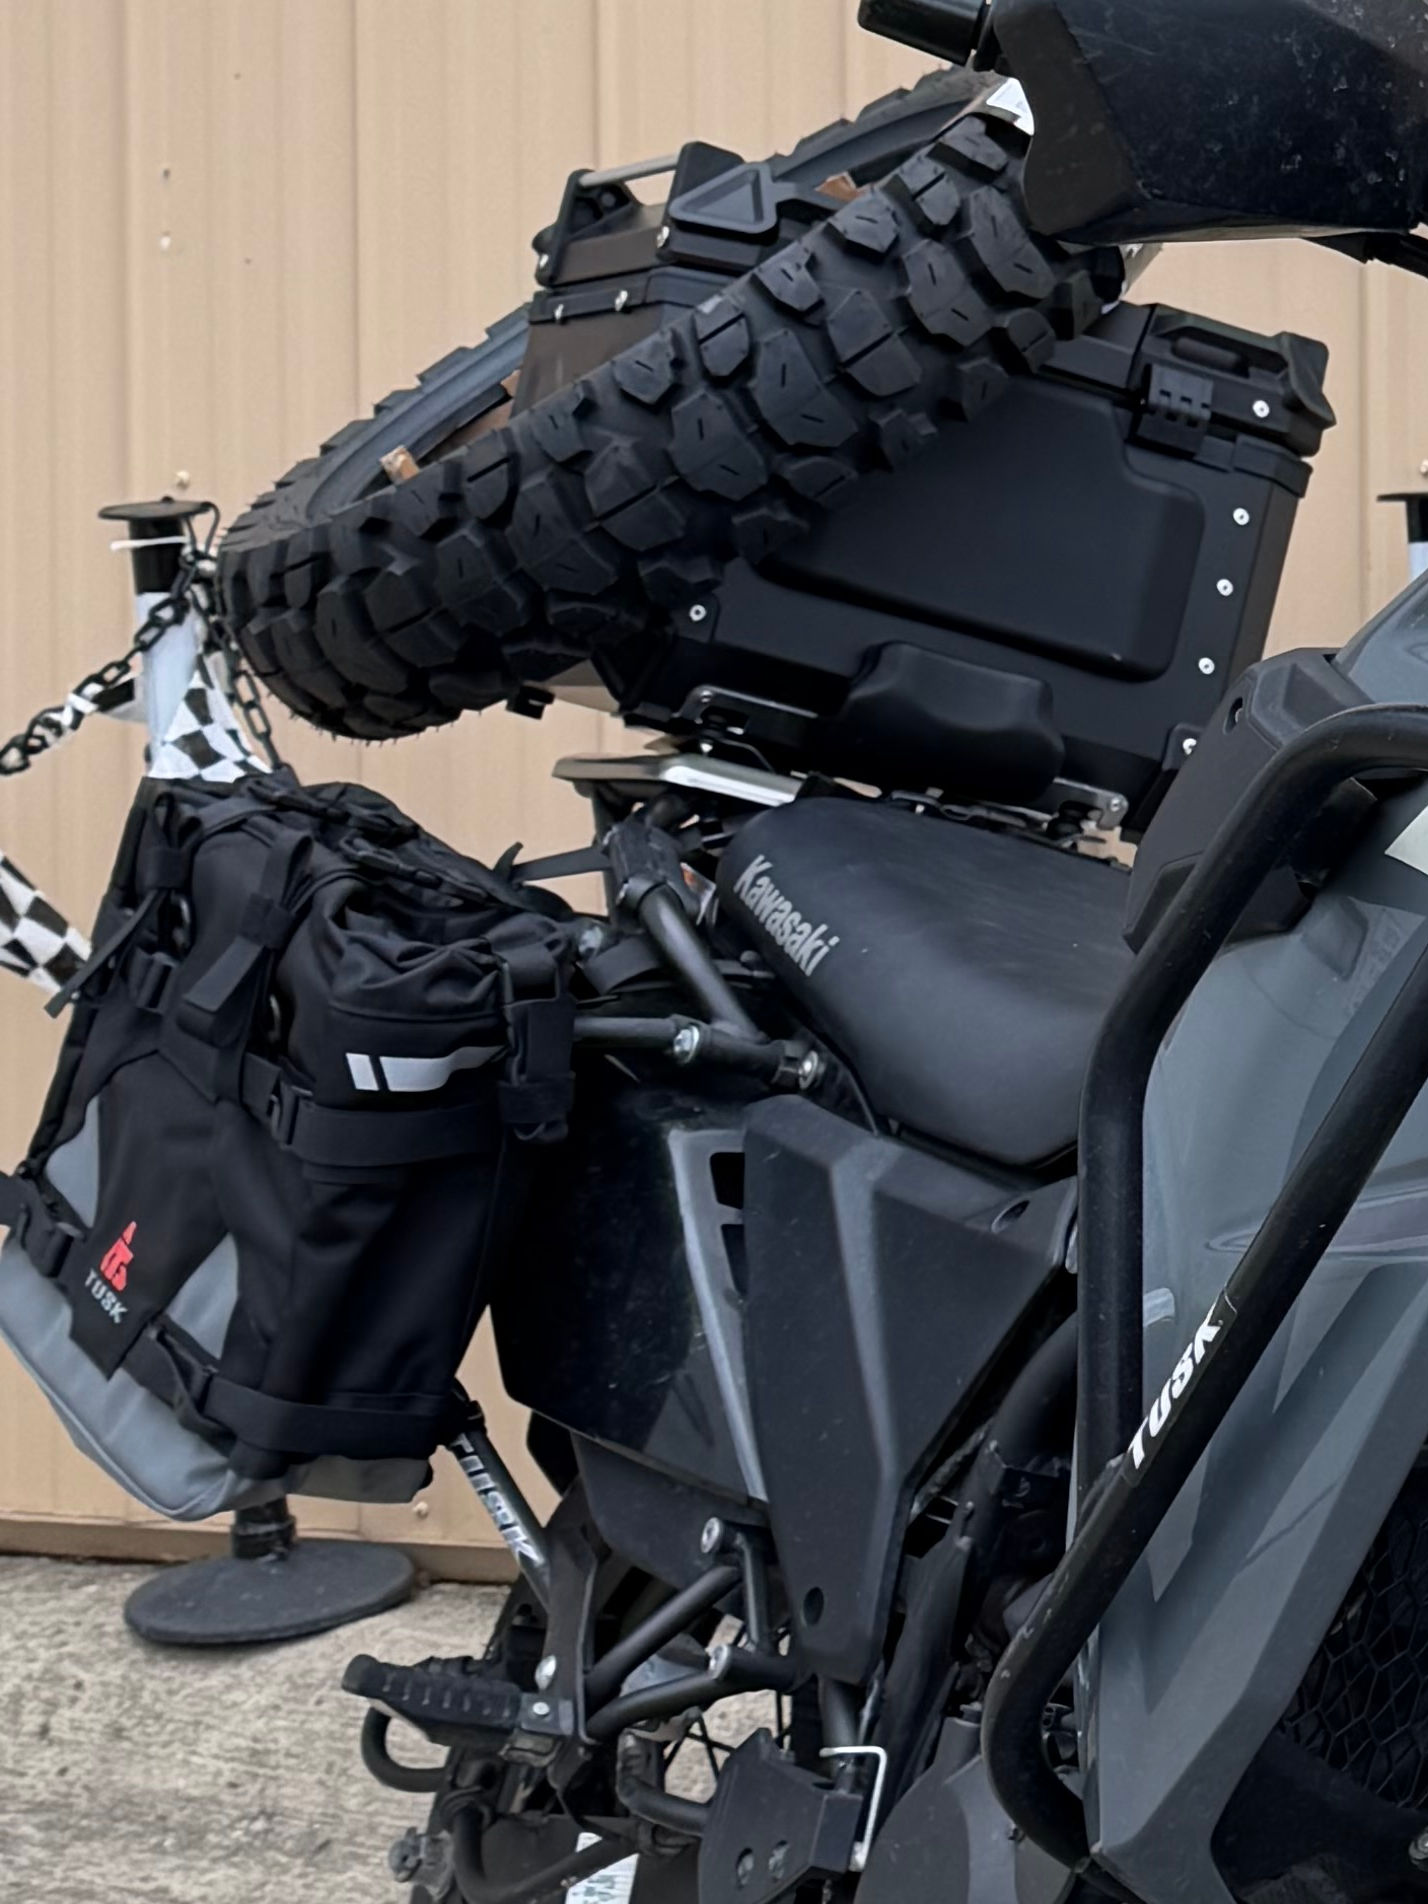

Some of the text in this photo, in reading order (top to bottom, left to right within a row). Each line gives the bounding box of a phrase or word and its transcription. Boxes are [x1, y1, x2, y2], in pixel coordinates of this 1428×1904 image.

[734, 854, 840, 977] Kawasaki
[85, 1268, 128, 1324] TUSK
[1127, 1300, 1221, 1470] TUSK
